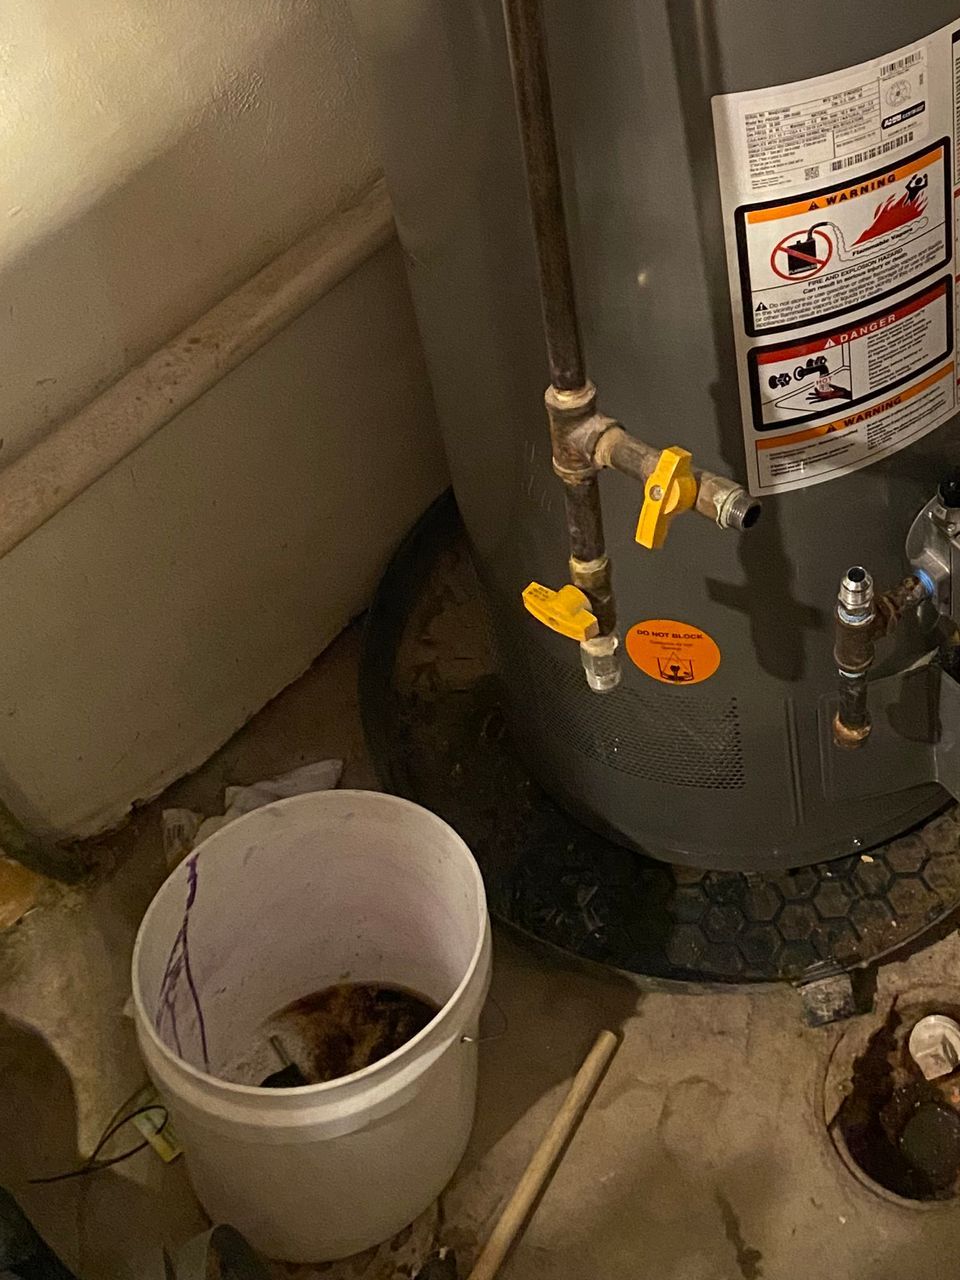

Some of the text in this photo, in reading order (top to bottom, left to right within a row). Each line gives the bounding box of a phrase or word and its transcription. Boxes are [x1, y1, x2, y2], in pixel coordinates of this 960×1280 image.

[825, 173, 896, 206] WARNING
[852, 239, 889, 256] Flammable
[803, 286, 816, 295] Can
[817, 281, 835, 290] result
[844, 271, 866, 282] serious
[867, 264, 883, 274] injury
[808, 247, 903, 287] FIRE AND EXPLOSION HAZARD
[840, 313, 897, 343] DANGER
[844, 396, 902, 428] WARNING
[636, 629, 704, 640] DO NOT BLOCK
